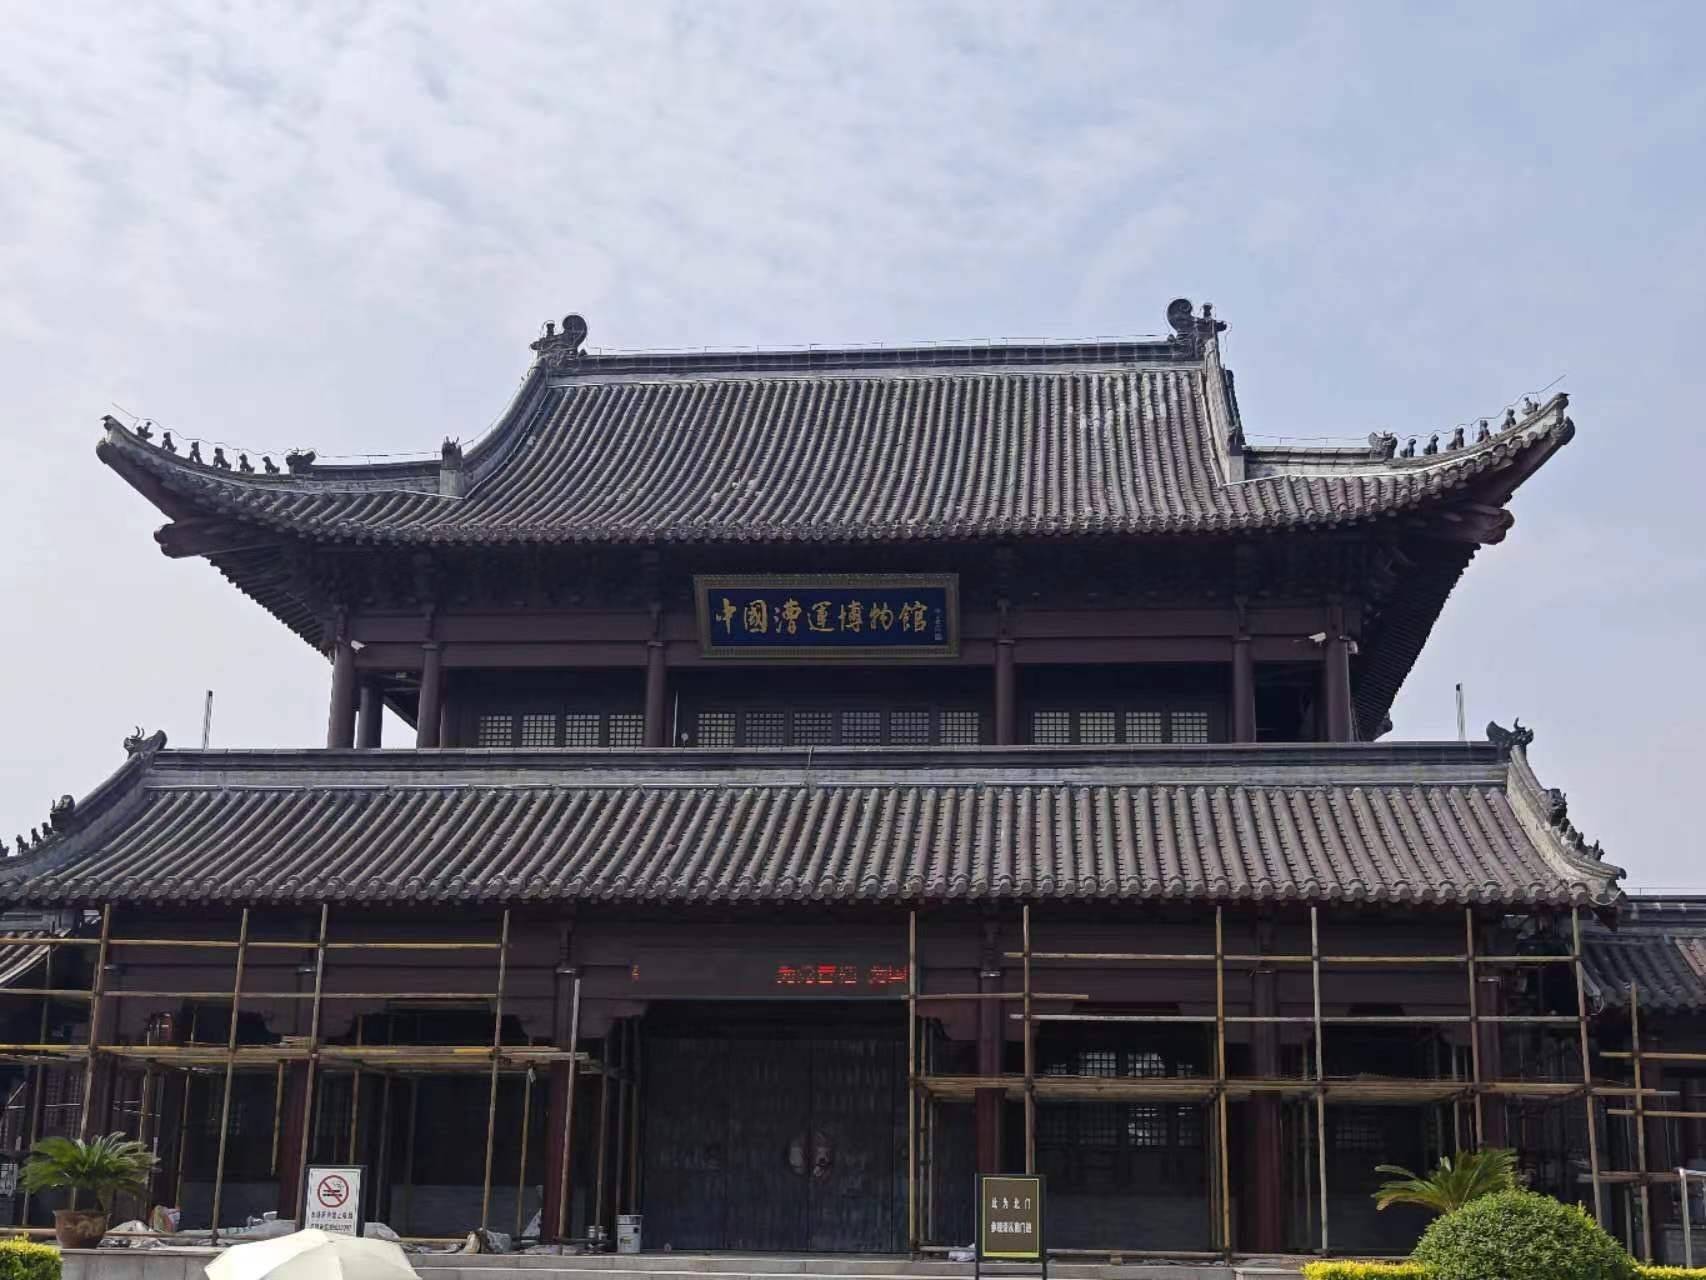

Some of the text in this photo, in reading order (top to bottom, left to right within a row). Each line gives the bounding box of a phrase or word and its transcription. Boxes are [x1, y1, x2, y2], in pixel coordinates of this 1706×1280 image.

[716, 598, 928, 634] 中國漕運博物館
